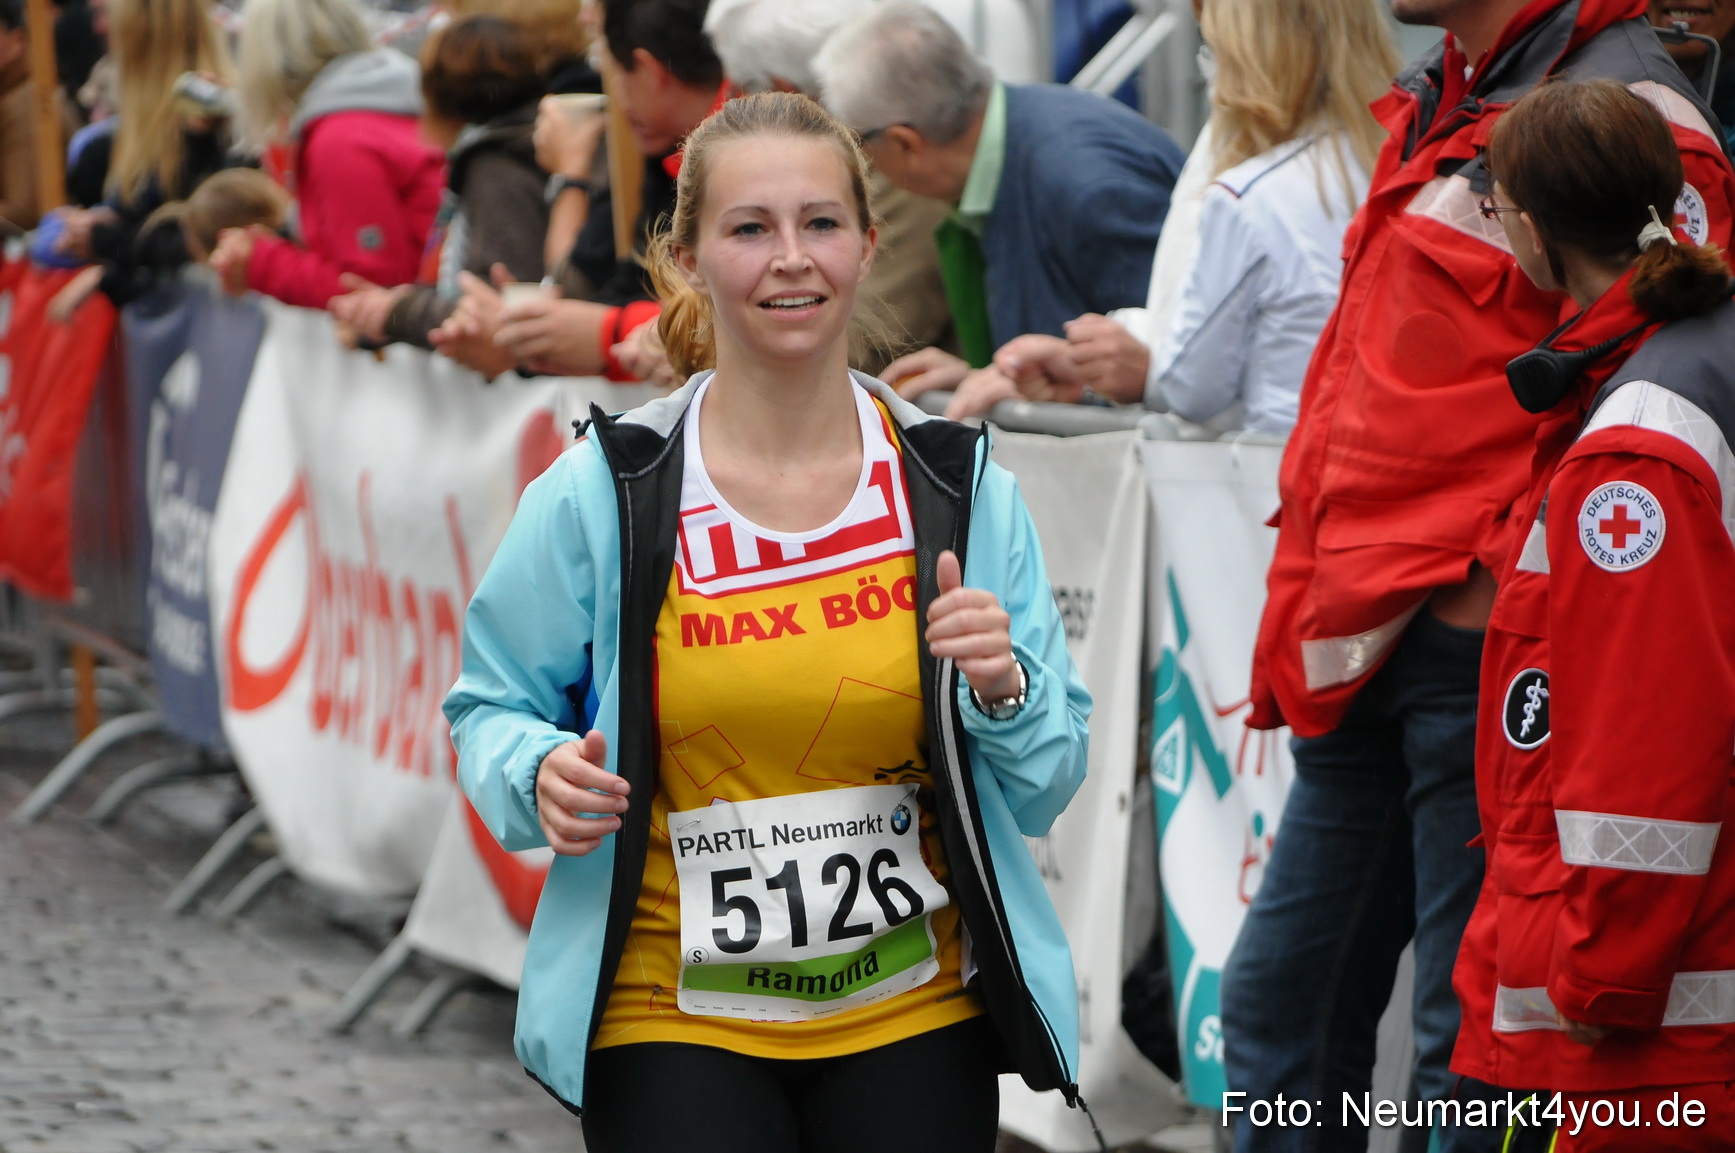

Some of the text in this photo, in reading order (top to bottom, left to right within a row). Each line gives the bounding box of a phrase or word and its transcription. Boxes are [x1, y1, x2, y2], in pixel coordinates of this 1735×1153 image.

[1586, 487, 1656, 519] DEUTSCHES
[1585, 528, 1657, 565] ROTES KREUZ
[680, 603, 807, 648] MAX
[677, 813, 883, 858] PARTL Neumarkt
[710, 848, 924, 954] 5126
[693, 950, 702, 963] S
[747, 950, 880, 995] Ramona
